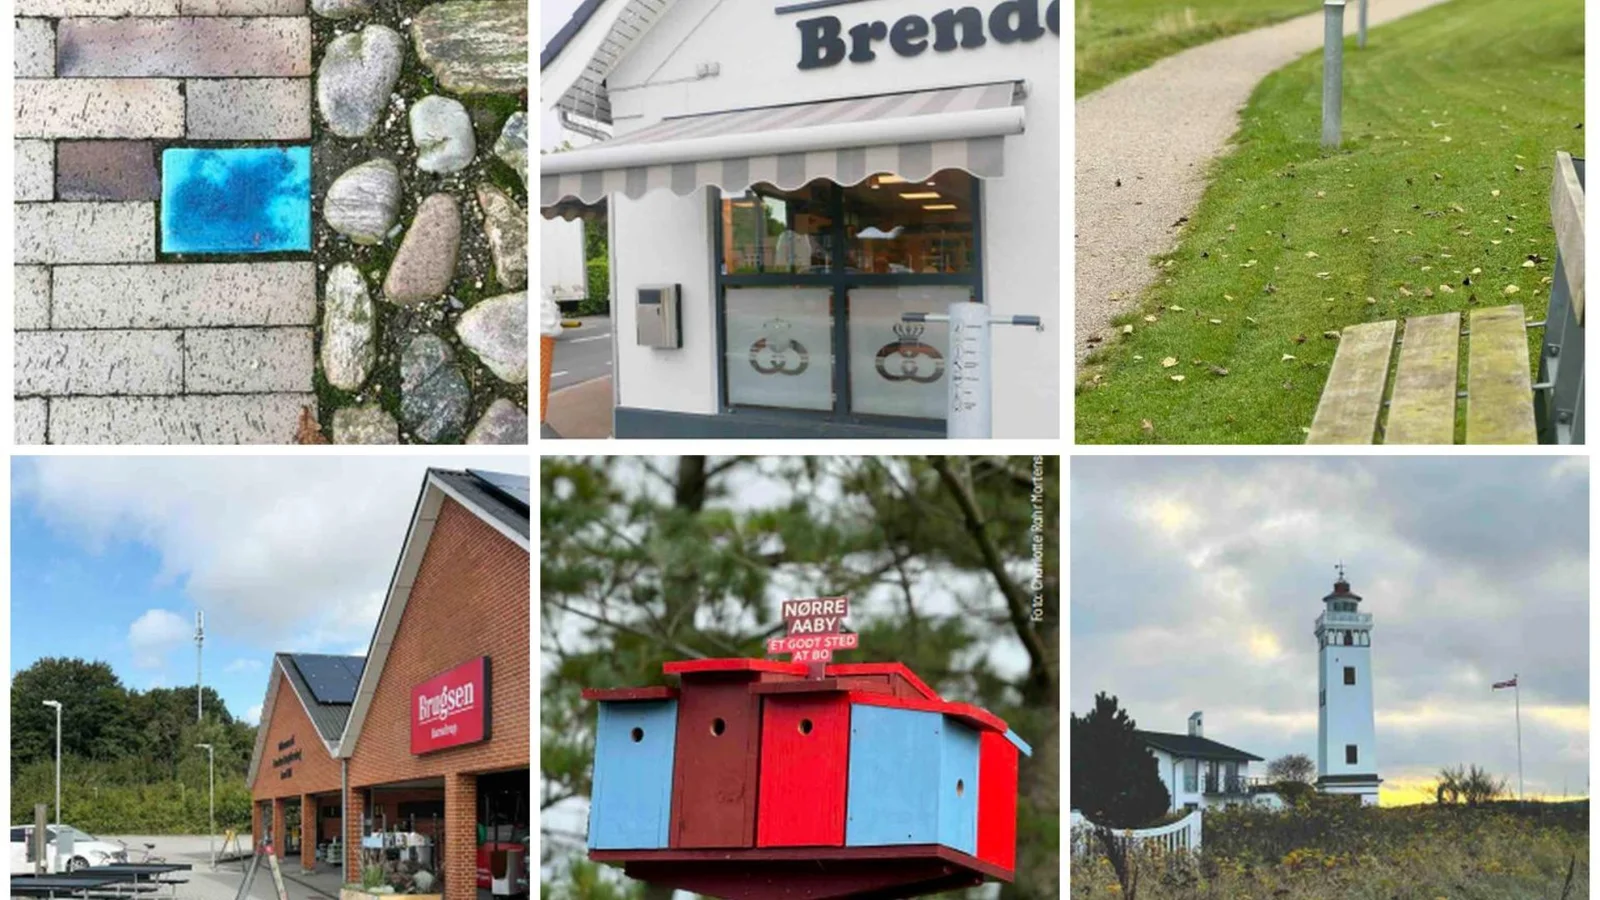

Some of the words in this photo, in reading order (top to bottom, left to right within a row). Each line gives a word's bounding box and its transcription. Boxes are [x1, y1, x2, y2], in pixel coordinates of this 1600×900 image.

[784, 599, 845, 617] NØRRE
[791, 616, 836, 634] AABY
[770, 639, 785, 651] ET
[787, 637, 821, 649] GODT
[824, 635, 855, 647] STED
[793, 650, 809, 661] AT
[812, 648, 829, 660] BO
[418, 681, 474, 721] Brugsen
